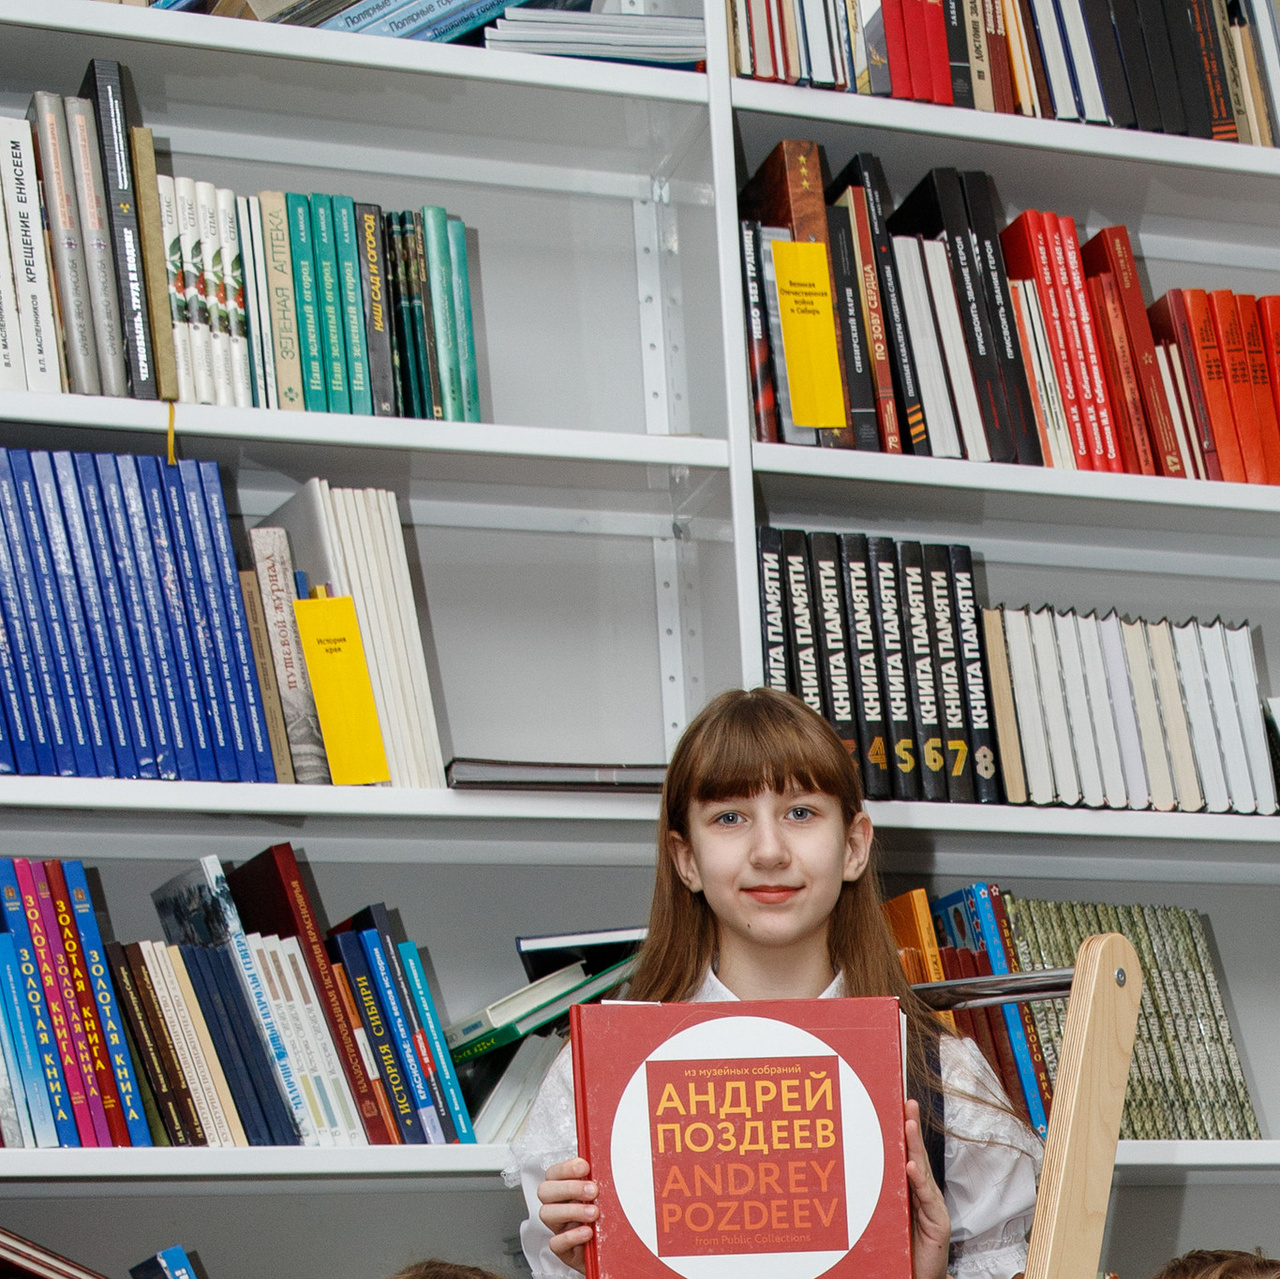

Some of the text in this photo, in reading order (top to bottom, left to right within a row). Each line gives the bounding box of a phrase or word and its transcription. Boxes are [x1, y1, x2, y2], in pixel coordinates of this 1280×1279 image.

[388, 2, 437, 34] Полярные
[10, 139, 27, 204] ЕНИСЕЕМ
[18, 210, 38, 284] КРЕЩЕНИЕ
[363, 213, 383, 332] НАШ САД И ОГОРОД
[267, 209, 295, 360] ЗЕЛЕНАЯ АПТЕКА
[743, 230, 762, 339] НЕБО БЕЗ ГРАНИЦ
[862, 263, 885, 360] ПО ЗОВУ СЕРДЦА
[30, 294, 44, 355] МАСЛЕННИКОВ
[299, 259, 321, 390] Наш зеленый огород
[845, 287, 863, 373] СИБИРСКИЙ МАРШ
[315, 634, 347, 647] История
[849, 560, 881, 721] КНИГА ПАМЯТИ
[905, 565, 938, 725] КНИГА ПАМЯТИ
[930, 569, 963, 729] КНИГА ПАМЯТИ
[955, 570, 988, 729] КНИГА ПАМЯТИ
[234, 631, 263, 752] КРАСНОЯРСКИЕ ВРАЧИ ТРЕХ СТОЛЕТИЙ
[867, 736, 887, 770] 4
[895, 739, 915, 773] 5
[924, 738, 944, 772] 6
[947, 740, 968, 776] 7
[975, 745, 995, 779] 8
[56, 900, 106, 1071] ЗОЛОТАЯ КНИГА
[290, 879, 368, 1093] ИЛЛЮСТРИРОВАННАЯ ИСТОРИЯ КРАСНОЯРЬЯ
[20, 949, 67, 1121] ЗОЛОТАЯ КНИГА
[355, 974, 411, 1115] ИСТОРИЯ СИБИРИ
[684, 1063, 802, 1078] из музейных собраний
[656, 1071, 834, 1119] АНДРЕЙ
[656, 1118, 836, 1155] ПОЗДЕЕВ
[661, 1160, 837, 1198] ANDREY
[661, 1197, 839, 1232] POZDEEV
[695, 1232, 811, 1246] from Public Collections
